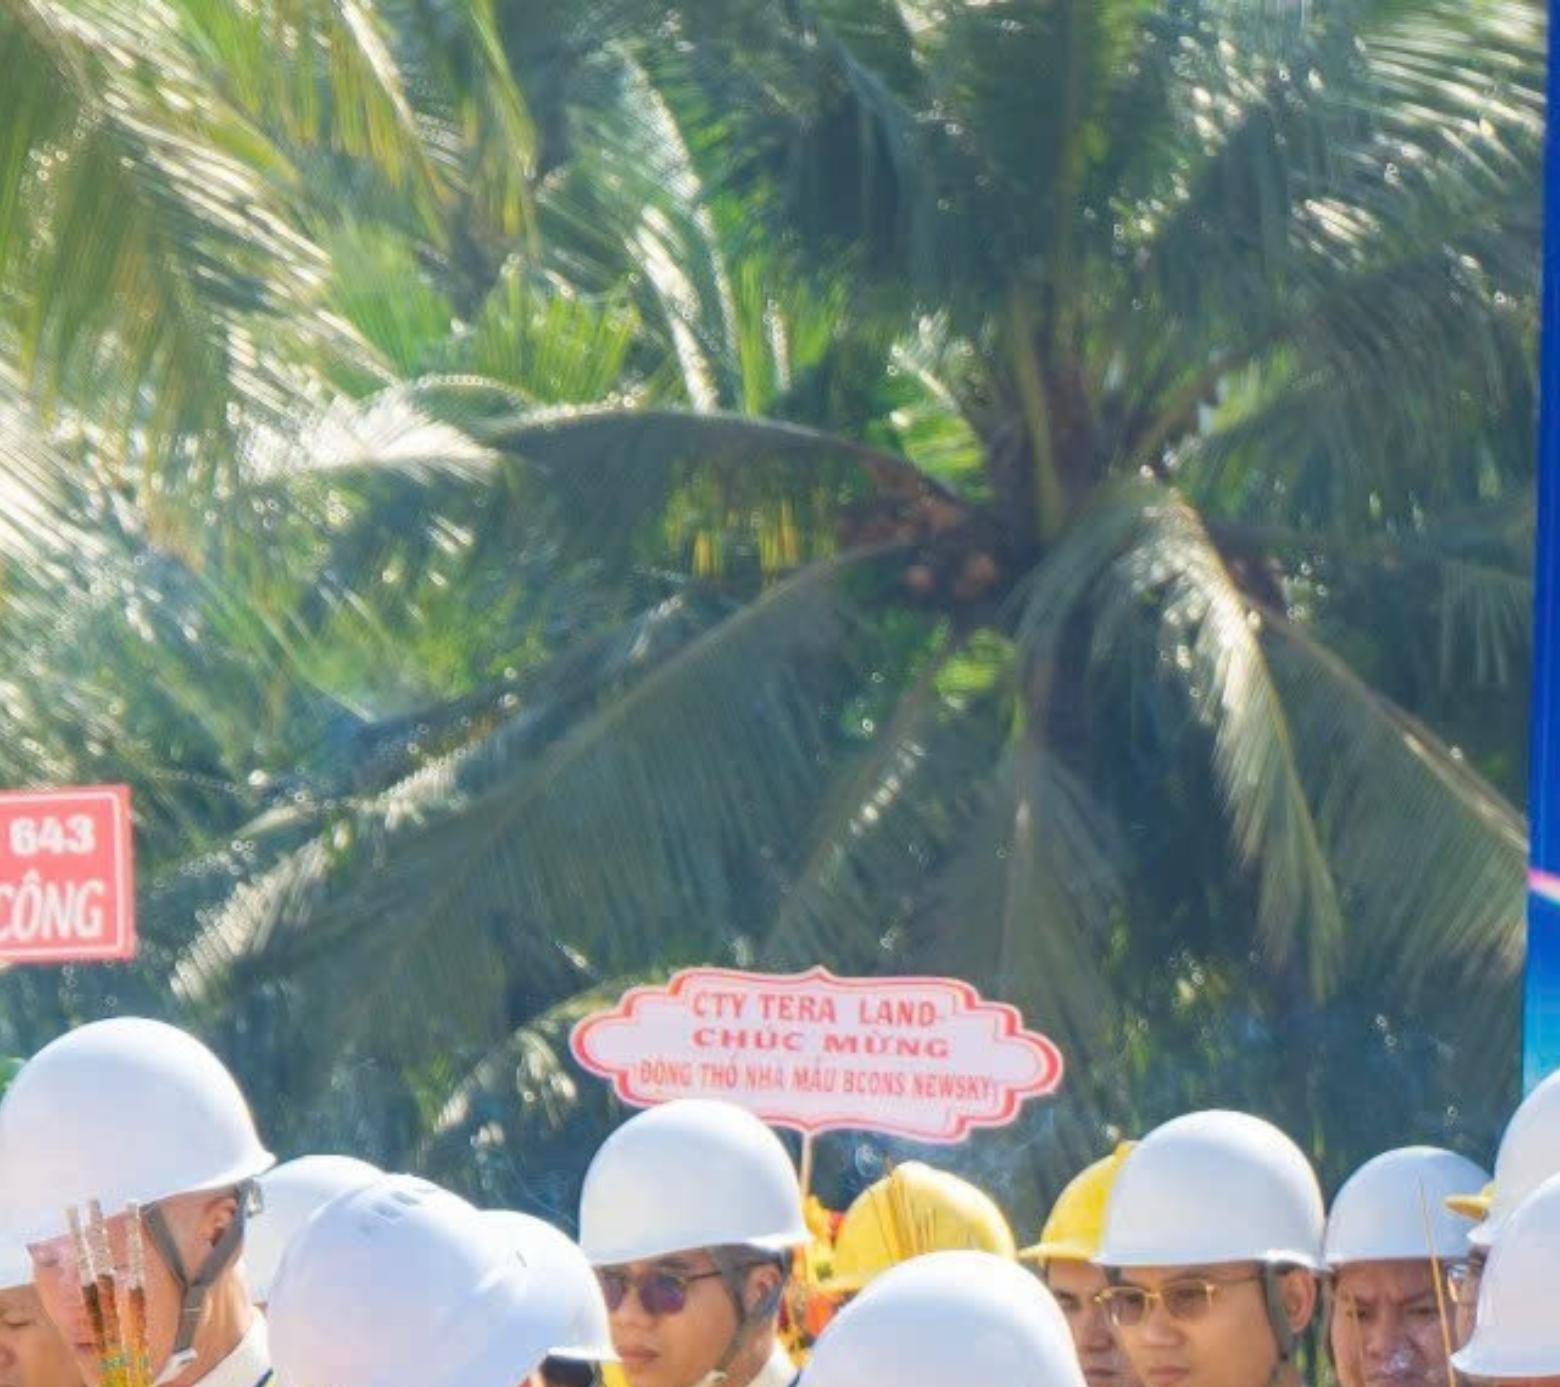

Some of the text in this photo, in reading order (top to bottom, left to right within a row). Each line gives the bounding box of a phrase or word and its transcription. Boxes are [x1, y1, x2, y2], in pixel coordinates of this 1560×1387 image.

[9, 813, 97, 857] 643
[692, 991, 938, 1027] CTY TERA LAND
[692, 1023, 951, 1059] CHÚC MỪNG
